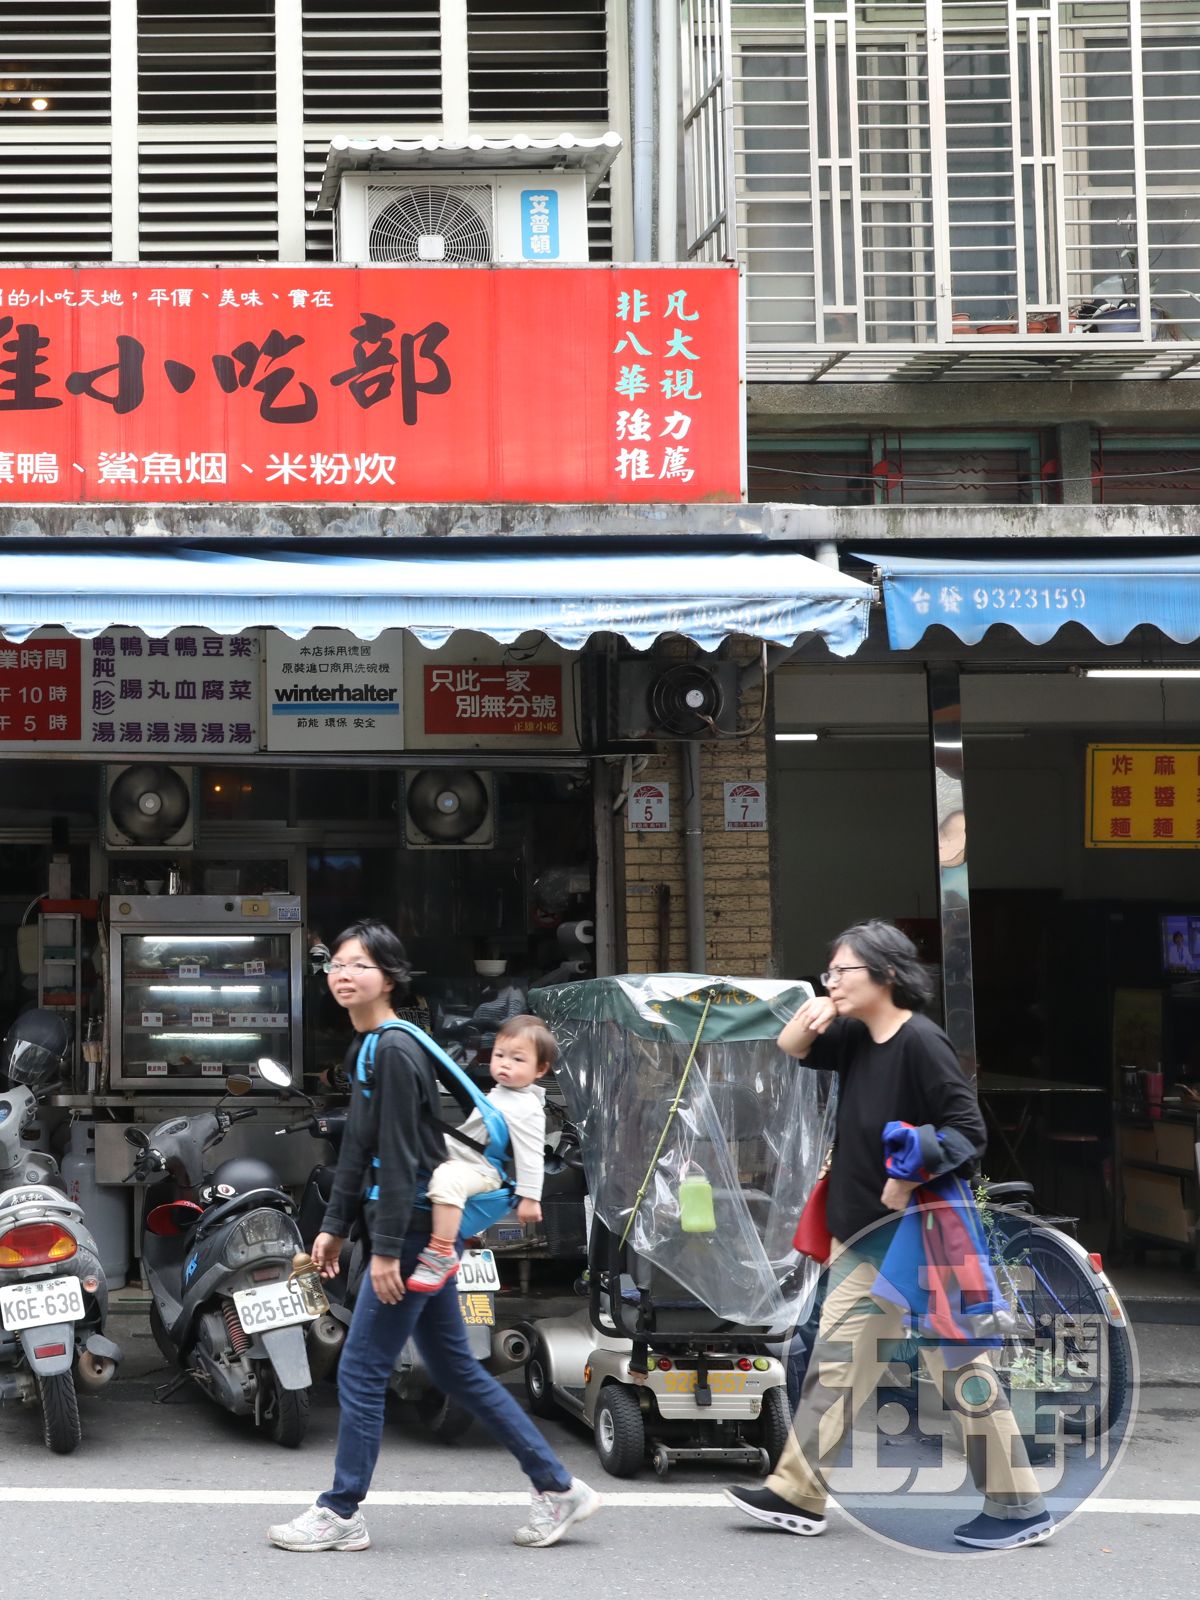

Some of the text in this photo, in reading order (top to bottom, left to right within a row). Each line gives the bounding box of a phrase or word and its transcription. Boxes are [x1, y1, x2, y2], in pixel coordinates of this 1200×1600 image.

[972, 587, 1086, 609] 9323159
[300, 646, 371, 657] 本店採用德國
[281, 662, 391, 674] 原裝進口商用洗碗機
[119, 637, 143, 743] 鴨腸湯
[174, 637, 198, 744] 鴨血湯
[201, 637, 225, 744] 豆腐湯
[228, 637, 253, 744] 紫菜湯
[430, 669, 531, 692] 只此一家
[18, 687, 43, 703] 10
[48, 686, 68, 703] 時
[275, 684, 398, 702] winterhalter
[456, 695, 557, 718] 別無分號
[24, 715, 37, 732] 5
[48, 714, 68, 731] 時
[297, 717, 376, 728] 節能 環保 安全
[1110, 755, 1133, 838] 炸醬麵
[1153, 755, 1176, 838] 麻醬麵
[644, 806, 653, 821] 5
[740, 805, 749, 820] 7
